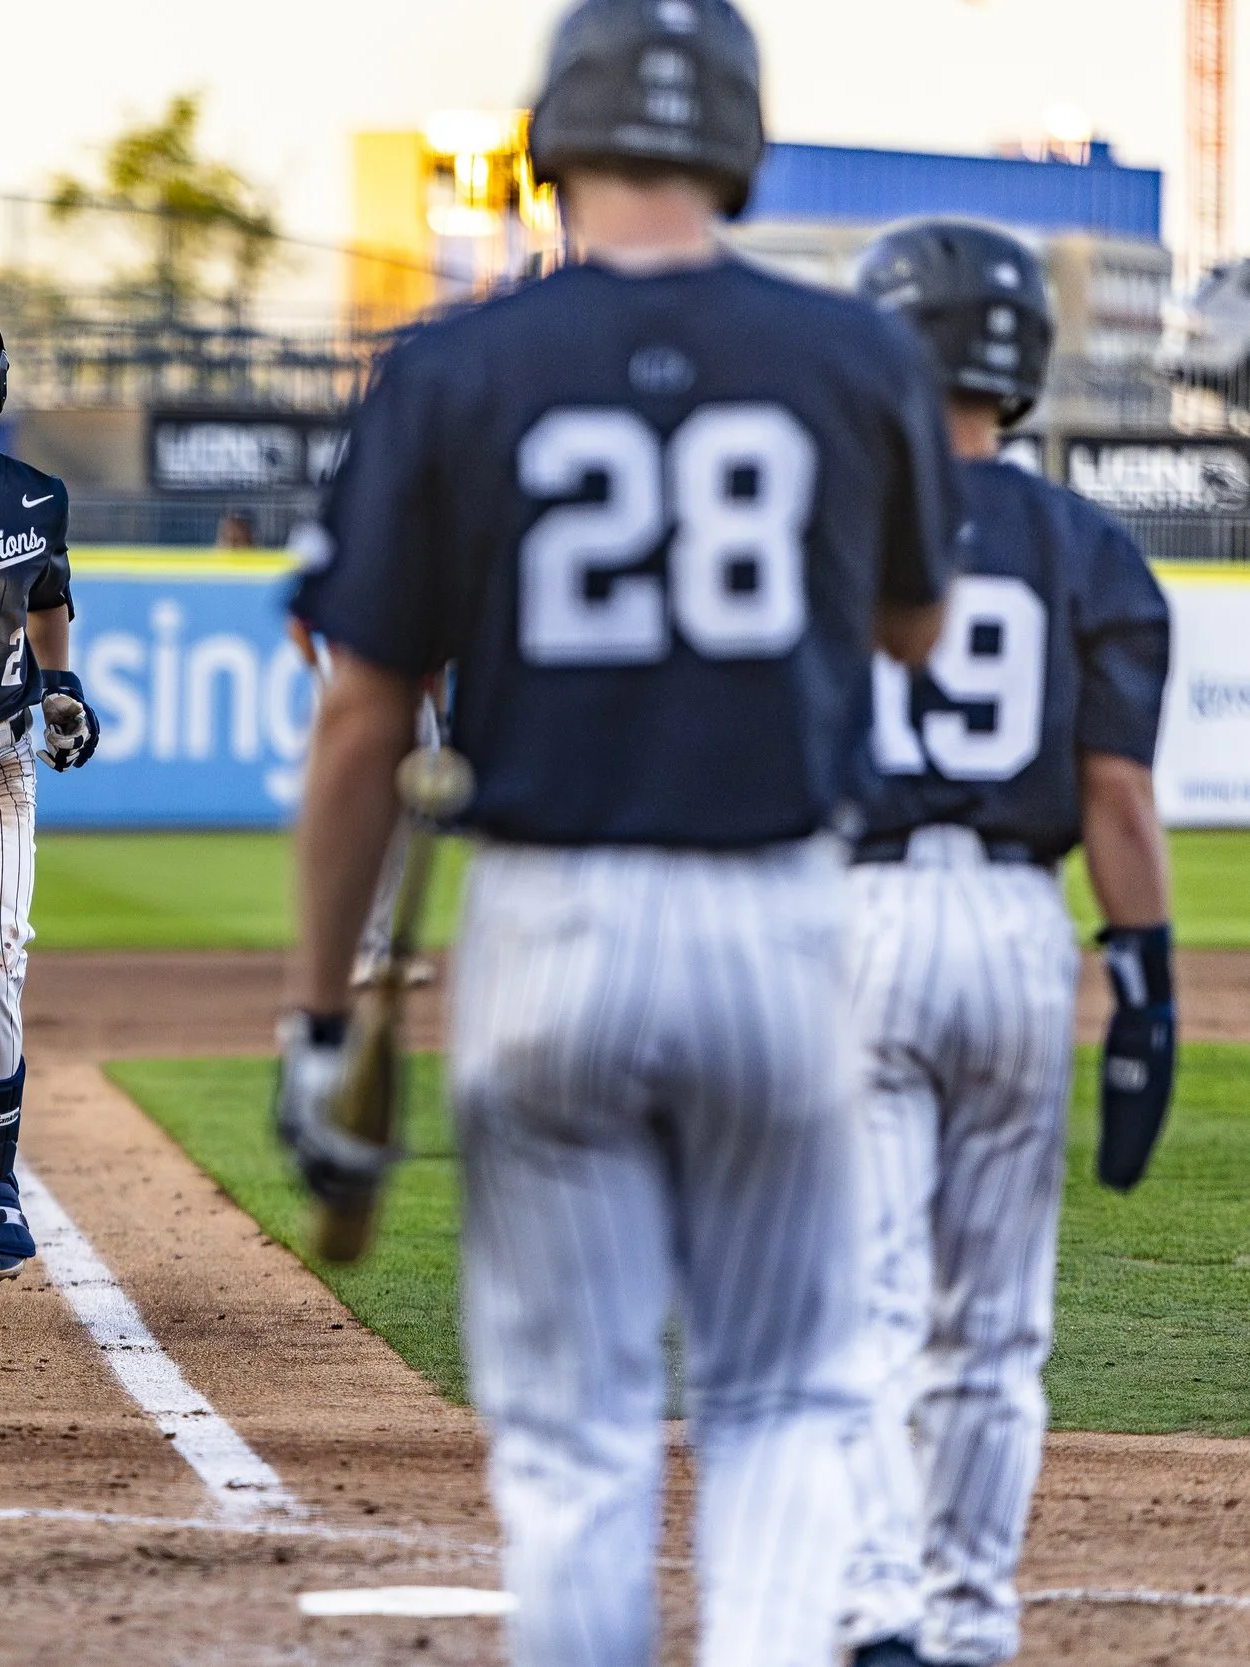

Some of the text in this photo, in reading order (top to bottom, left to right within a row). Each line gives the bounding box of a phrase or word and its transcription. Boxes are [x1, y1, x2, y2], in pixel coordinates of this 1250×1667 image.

[518, 402, 816, 664] 28
[1, 626, 25, 687] 2
[68, 598, 322, 805] sing
